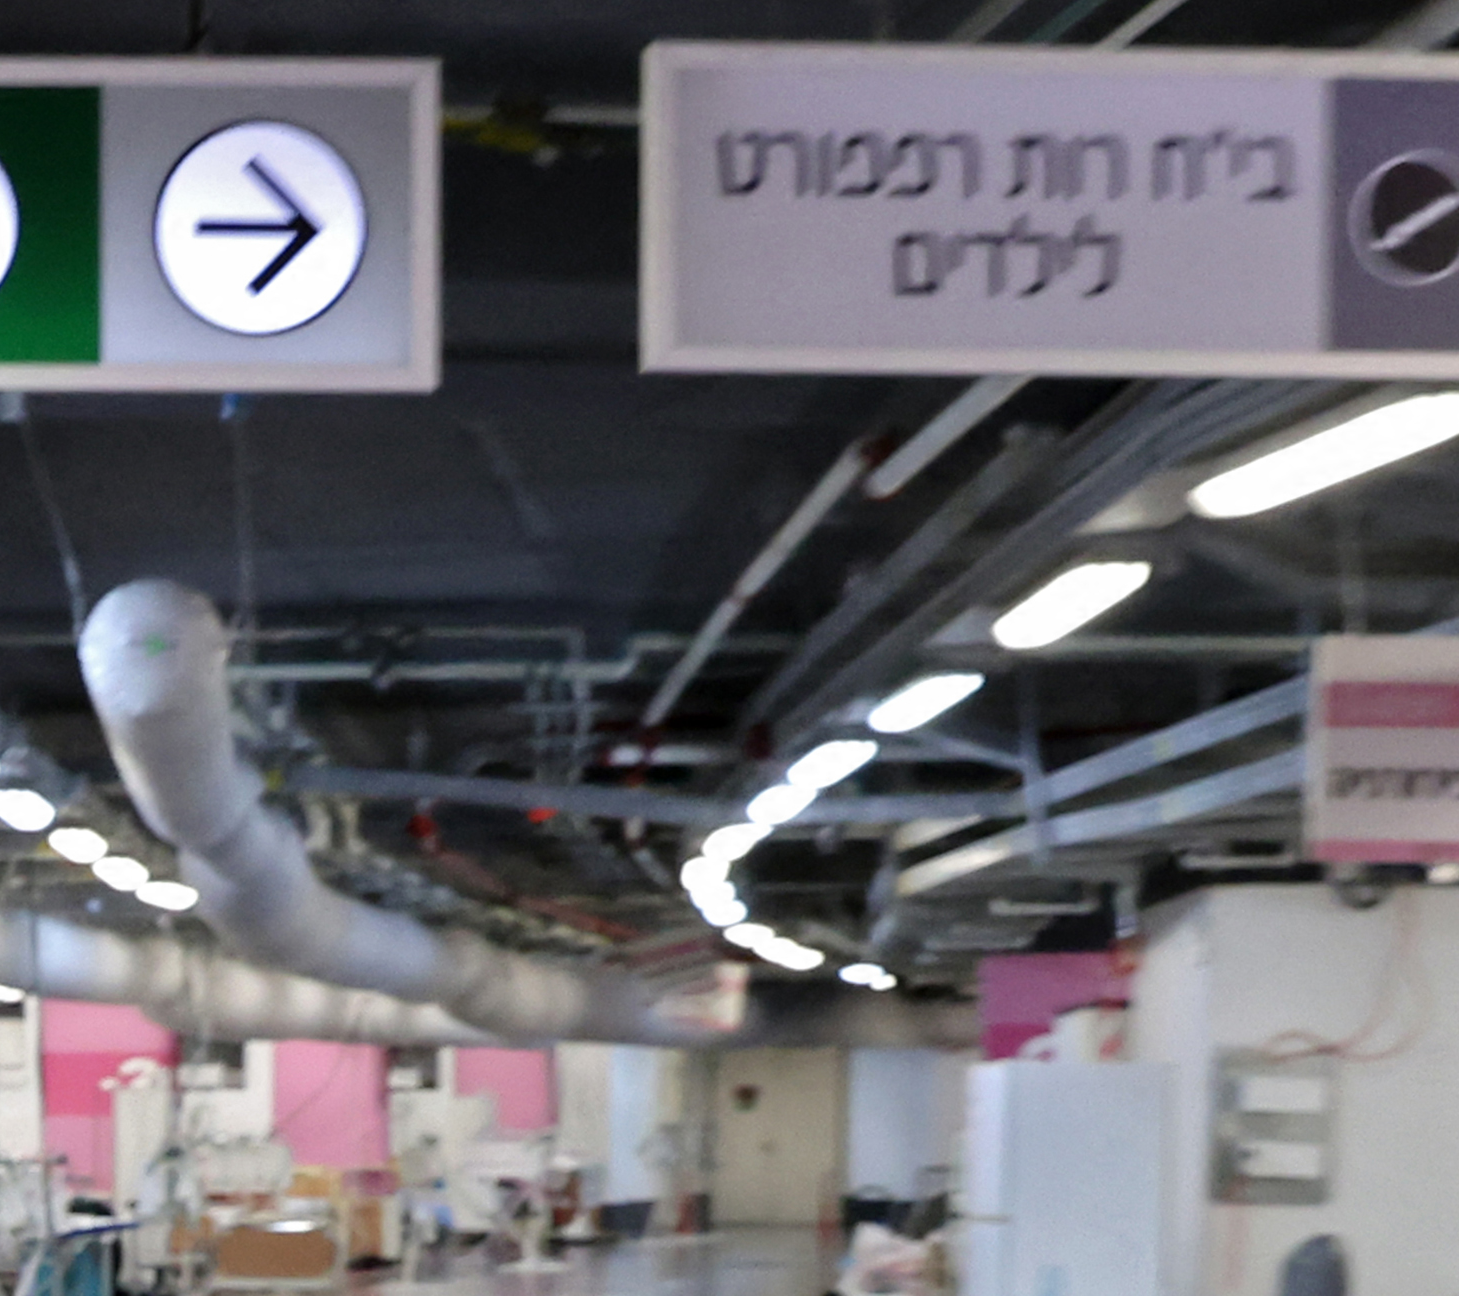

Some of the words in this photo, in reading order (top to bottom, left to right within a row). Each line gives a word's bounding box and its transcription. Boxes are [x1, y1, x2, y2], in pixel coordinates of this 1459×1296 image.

[715, 131, 980, 199] רפפורט
[1004, 133, 1130, 201] רות
[891, 213, 1122, 299] לילדים
